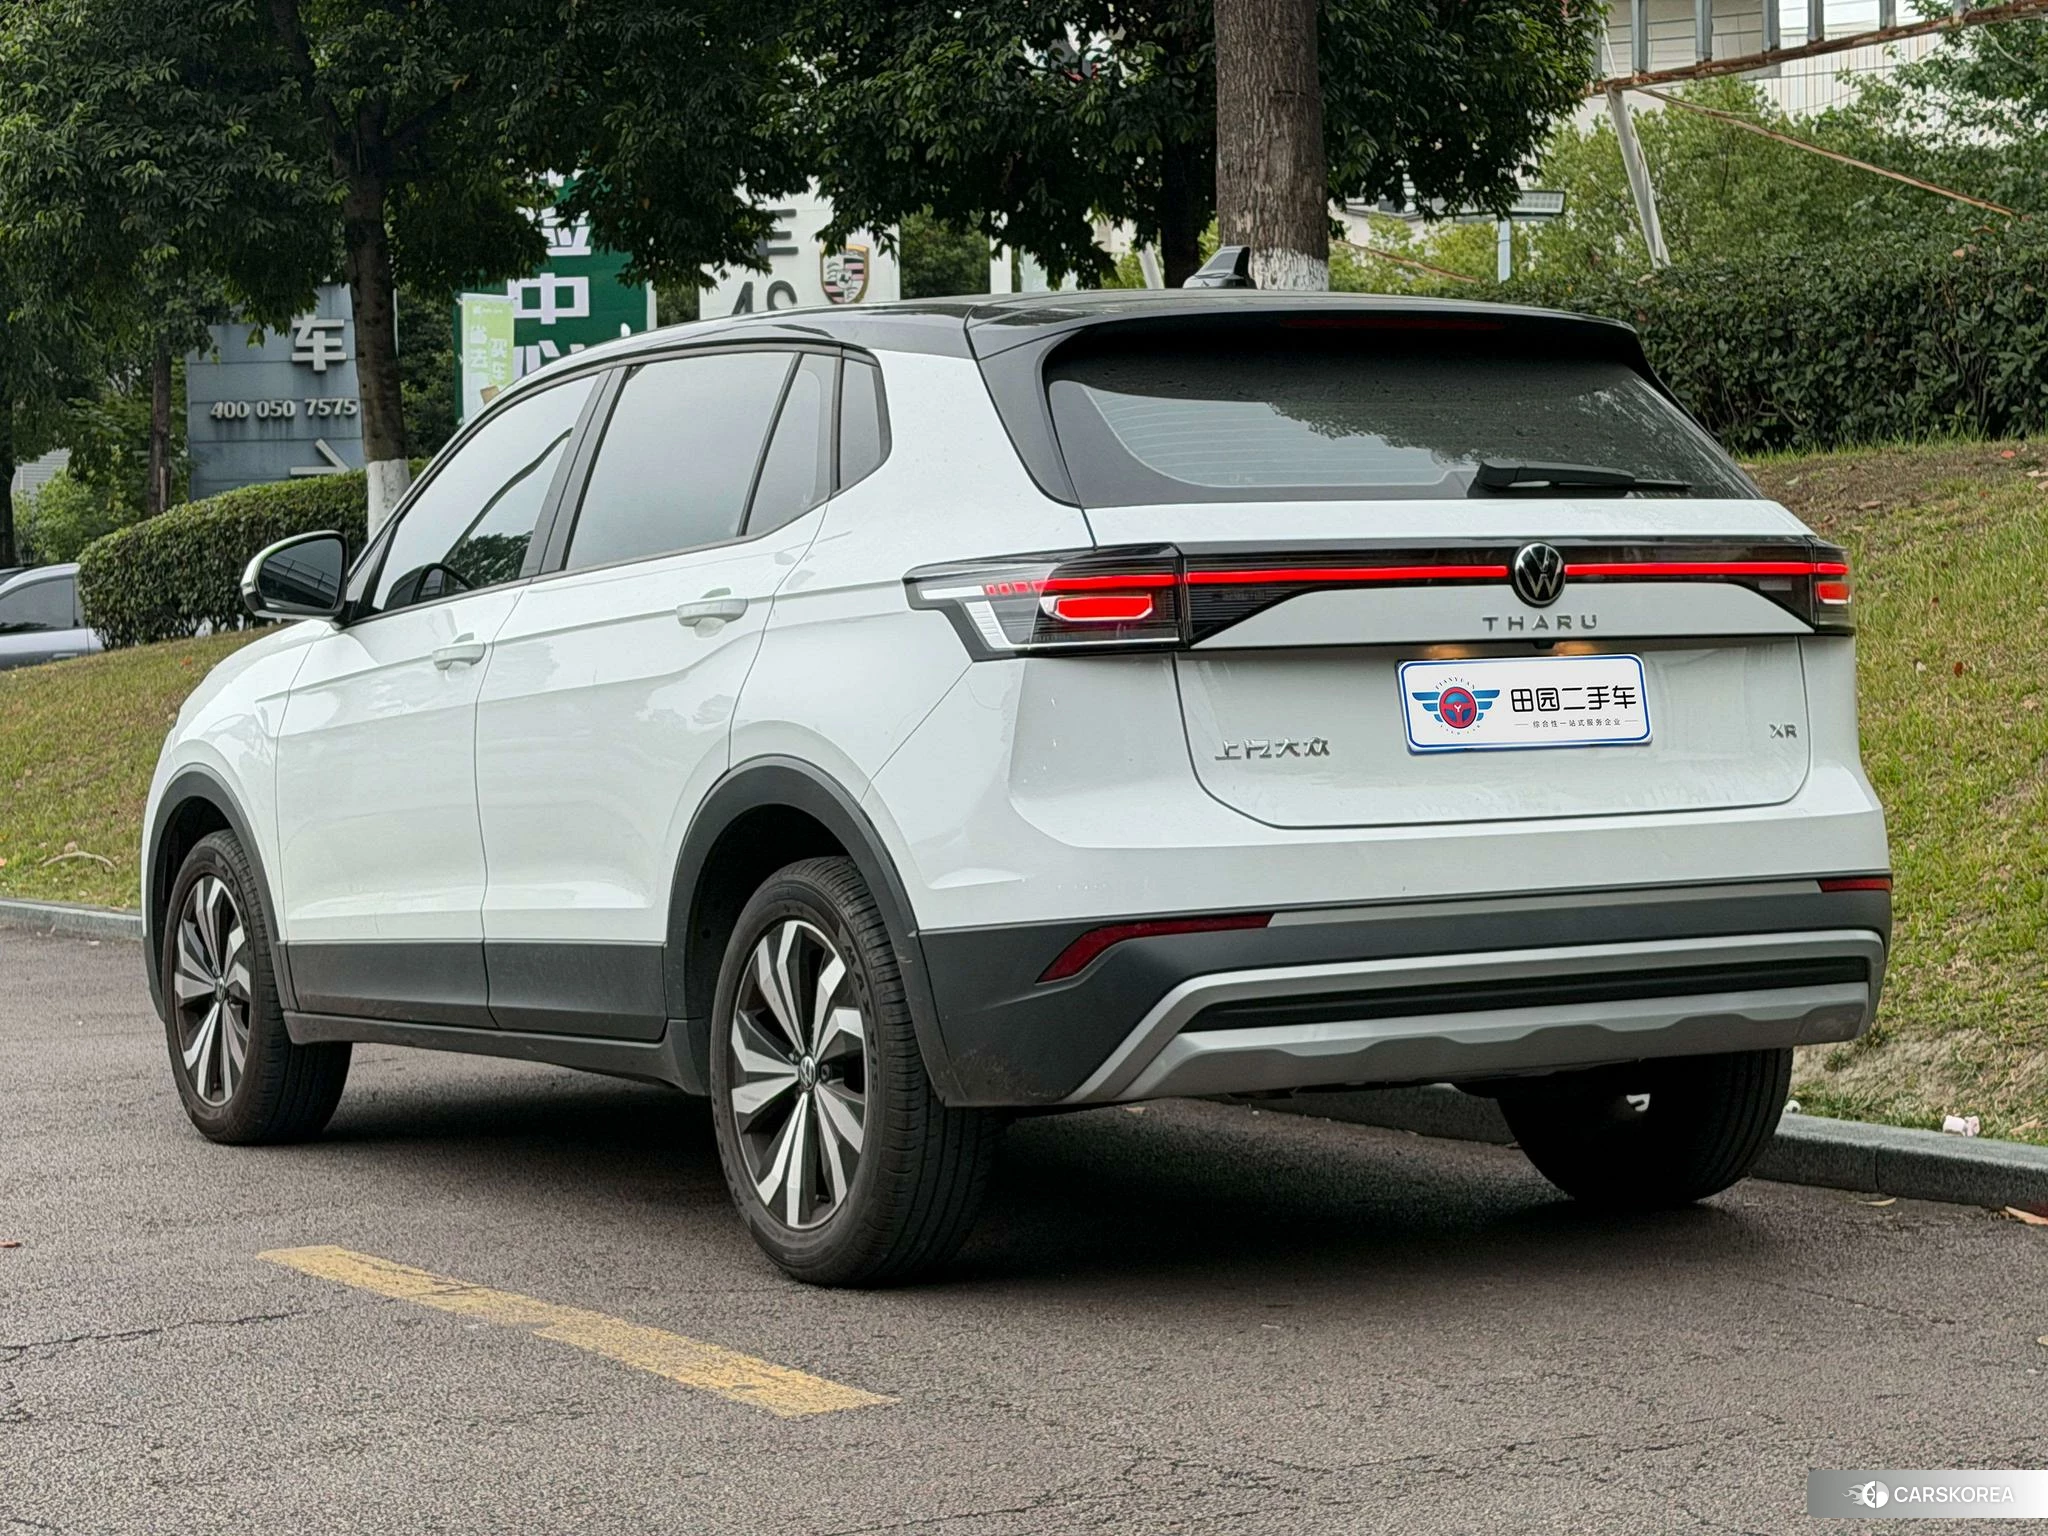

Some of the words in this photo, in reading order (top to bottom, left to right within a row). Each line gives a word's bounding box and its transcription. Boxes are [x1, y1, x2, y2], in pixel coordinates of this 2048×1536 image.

[291, 315, 347, 371] 车
[210, 400, 250, 419] 400
[256, 400, 296, 419] 050
[304, 398, 358, 417] 7575
[1482, 614, 1598, 632] THARU
[1510, 685, 1637, 713] 田园二手车
[1532, 718, 1621, 729] 综合性一站式服务企业
[1769, 723, 1797, 739] XR
